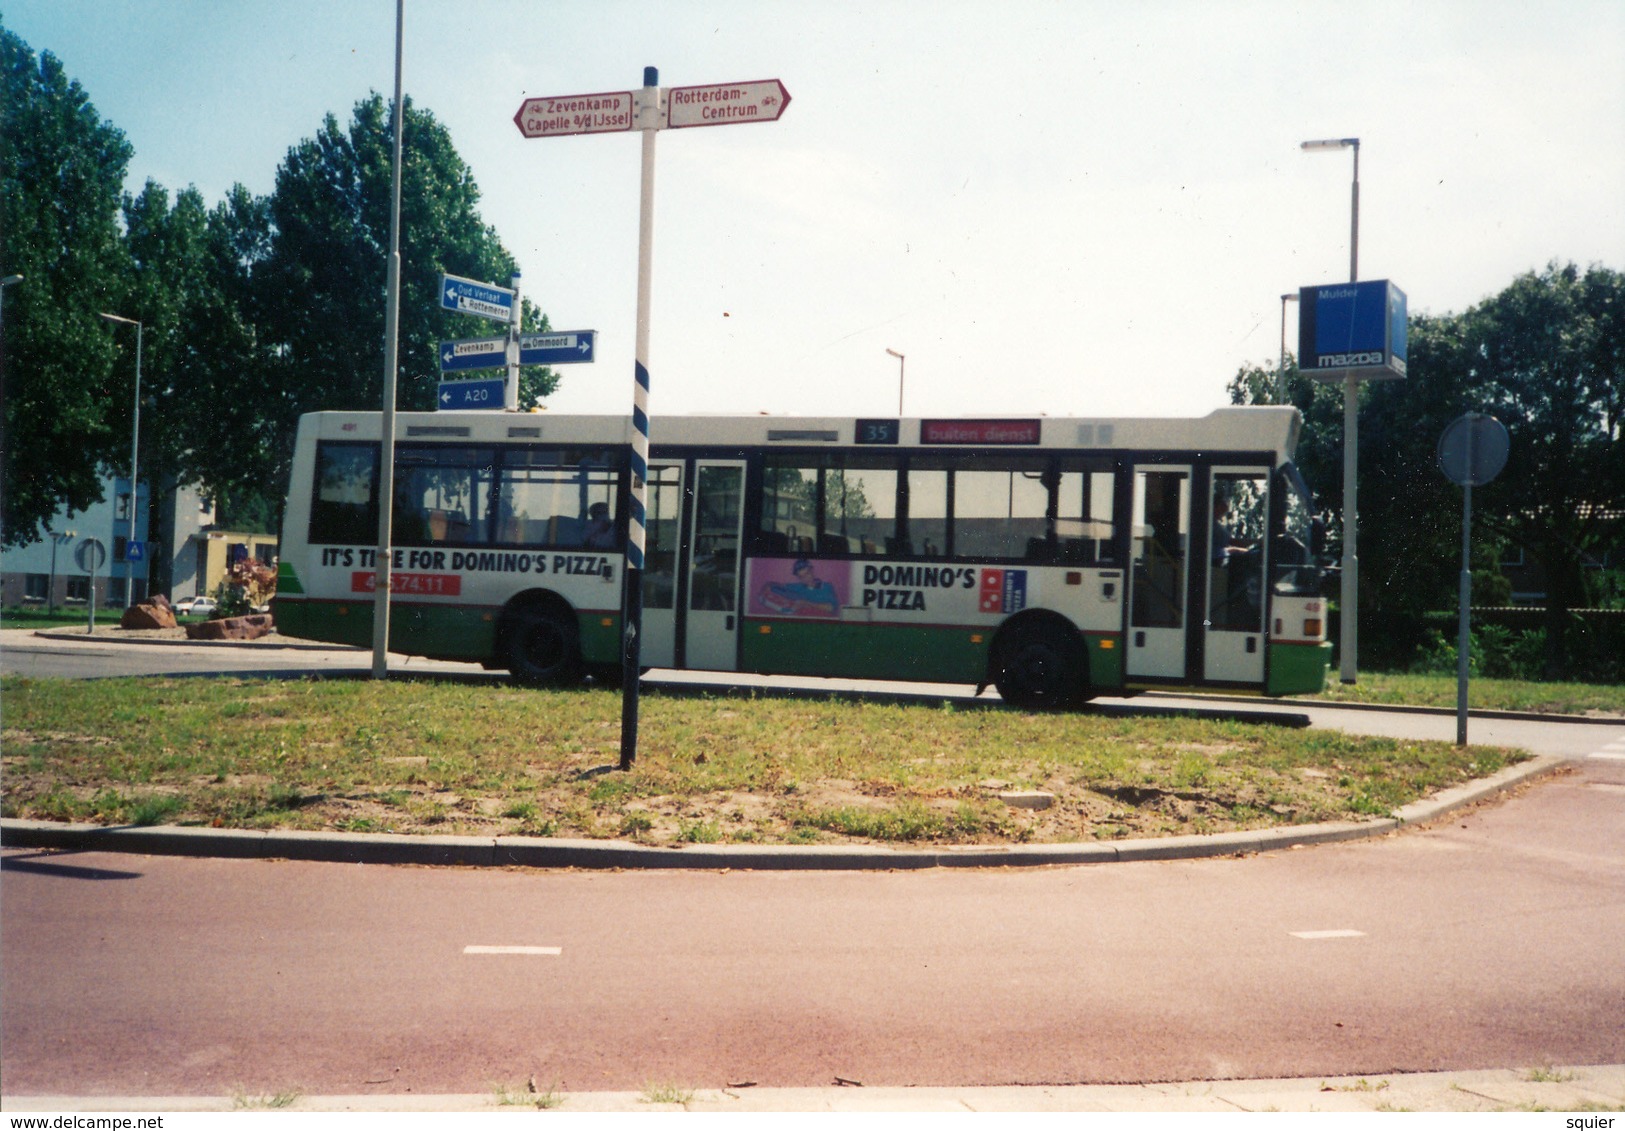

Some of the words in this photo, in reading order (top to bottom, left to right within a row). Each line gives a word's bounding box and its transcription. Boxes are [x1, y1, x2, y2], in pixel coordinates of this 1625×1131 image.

[674, 90, 747, 104] Rotterdam-
[546, 98, 621, 114] Zevenkamp
[701, 105, 758, 120] Centrum
[526, 118, 571, 132] Capelle
[593, 112, 629, 127] IJssel
[458, 285, 473, 296] Oud
[474, 287, 501, 304] Verlaat
[1319, 289, 1358, 299] Mulder
[470, 300, 508, 316] Rottemeren
[455, 343, 494, 354] Zevenkamp
[533, 337, 568, 347] Ommoord
[464, 389, 489, 402] A20
[867, 425, 888, 441] 35
[322, 547, 354, 568] IT'S
[359, 549, 404, 570] TIE
[409, 550, 447, 571] FOR
[451, 552, 547, 574] DOMINO'S
[863, 564, 977, 589] DOMINO'S
[864, 589, 926, 610] PIZZA
